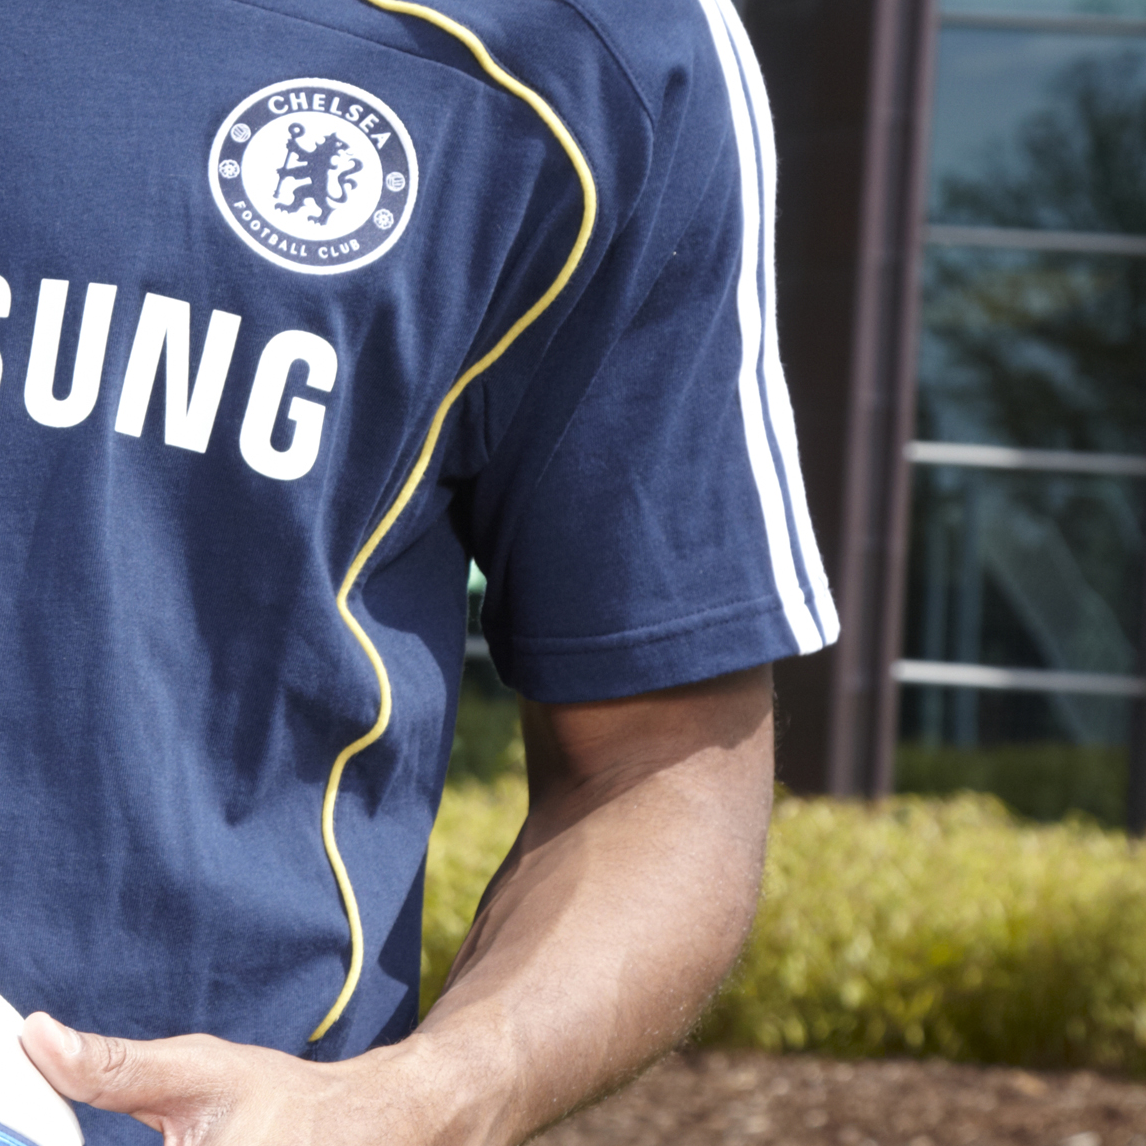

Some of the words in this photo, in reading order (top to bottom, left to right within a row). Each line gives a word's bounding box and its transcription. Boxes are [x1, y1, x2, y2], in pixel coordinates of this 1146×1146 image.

[267, 92, 392, 150] CHELSEA
[233, 200, 308, 258] FOOTBALL
[318, 238, 361, 259] CLUB
